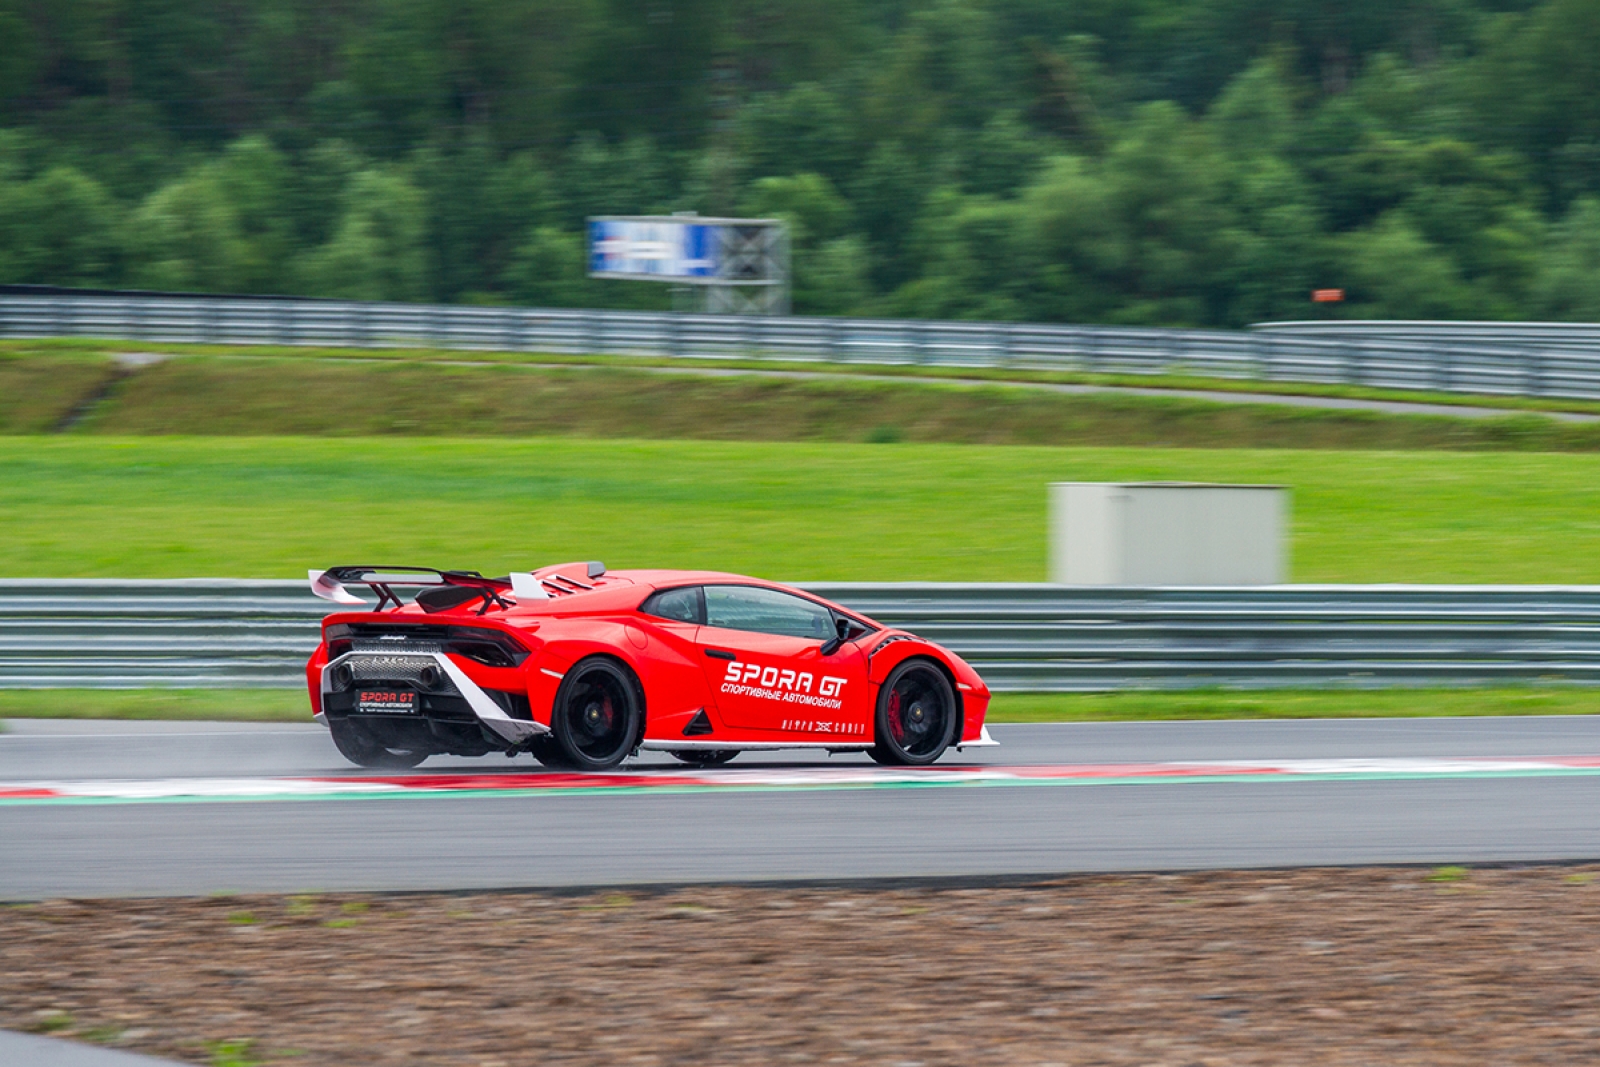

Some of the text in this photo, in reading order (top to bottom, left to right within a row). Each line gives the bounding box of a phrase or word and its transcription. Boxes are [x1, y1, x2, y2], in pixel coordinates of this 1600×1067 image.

[724, 661, 848, 696] SPORA GT
[360, 692, 414, 702] SPORA GT
[720, 682, 842, 709] СПОРТИВНЫЕ АВТОМОБИЛИ
